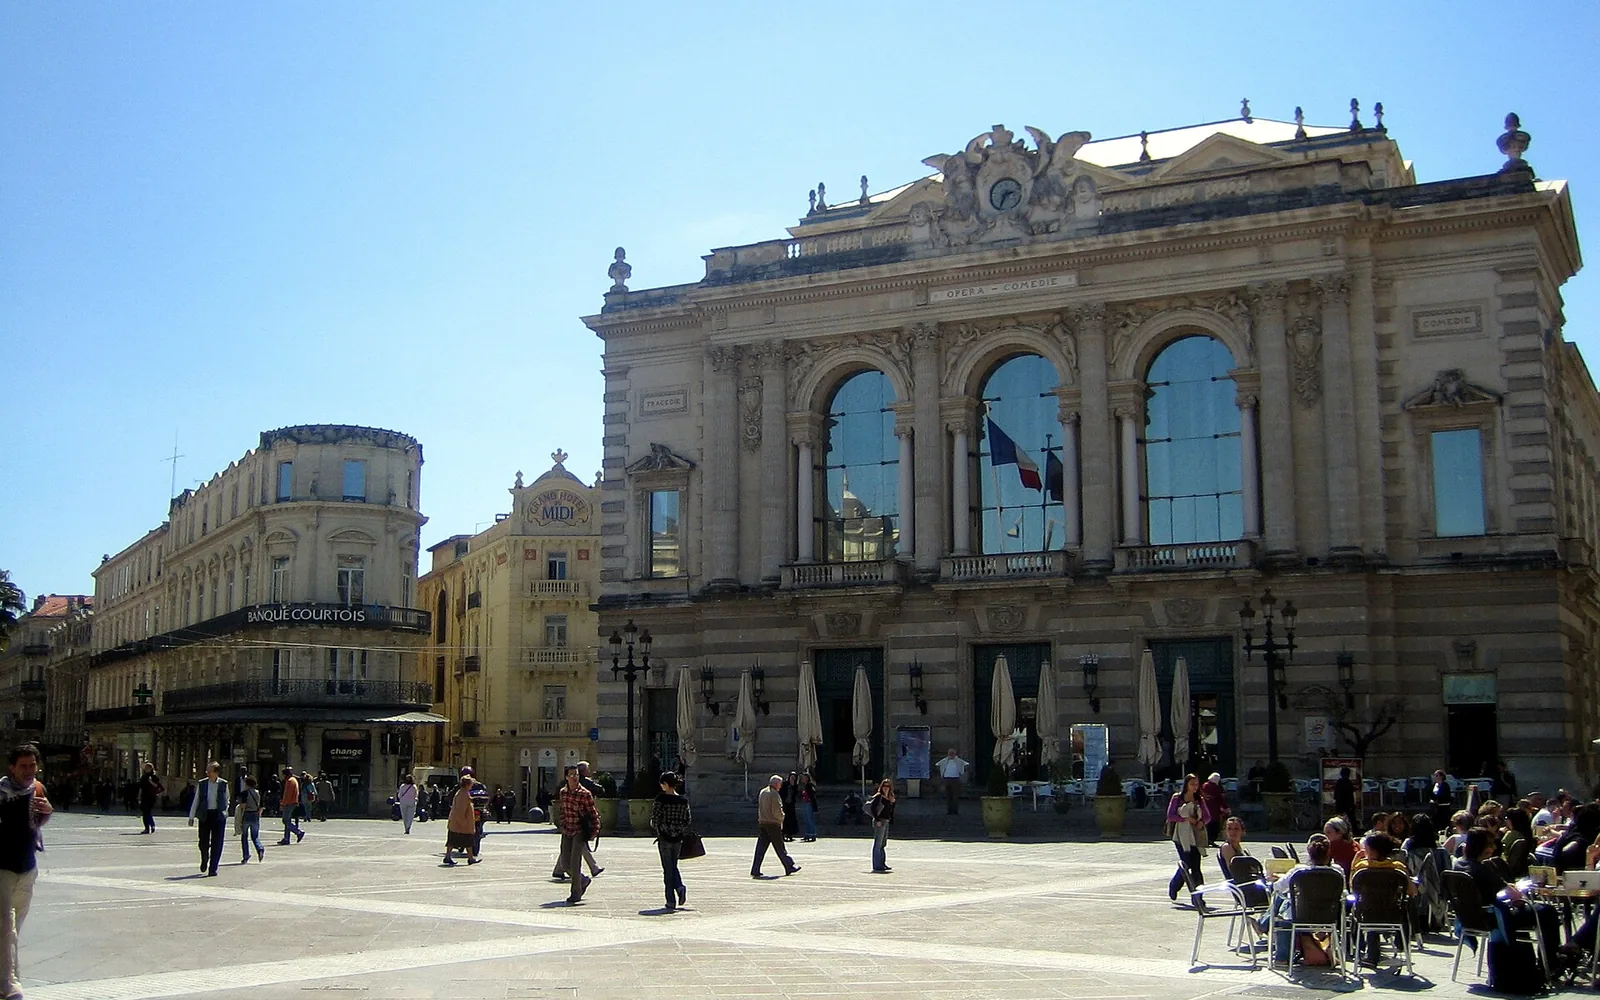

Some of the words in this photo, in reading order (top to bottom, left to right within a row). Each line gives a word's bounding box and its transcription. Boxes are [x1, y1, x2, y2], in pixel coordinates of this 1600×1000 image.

[946, 287, 985, 299] OPERA
[1003, 277, 1058, 292] COMEDIE
[530, 491, 557, 514] GRAND
[559, 491, 586, 512] HOTEL
[542, 506, 574, 520] MIDI
[248, 608, 290, 623] BANQUE
[291, 608, 365, 622] COURTOIS
[330, 747, 363, 756] change
